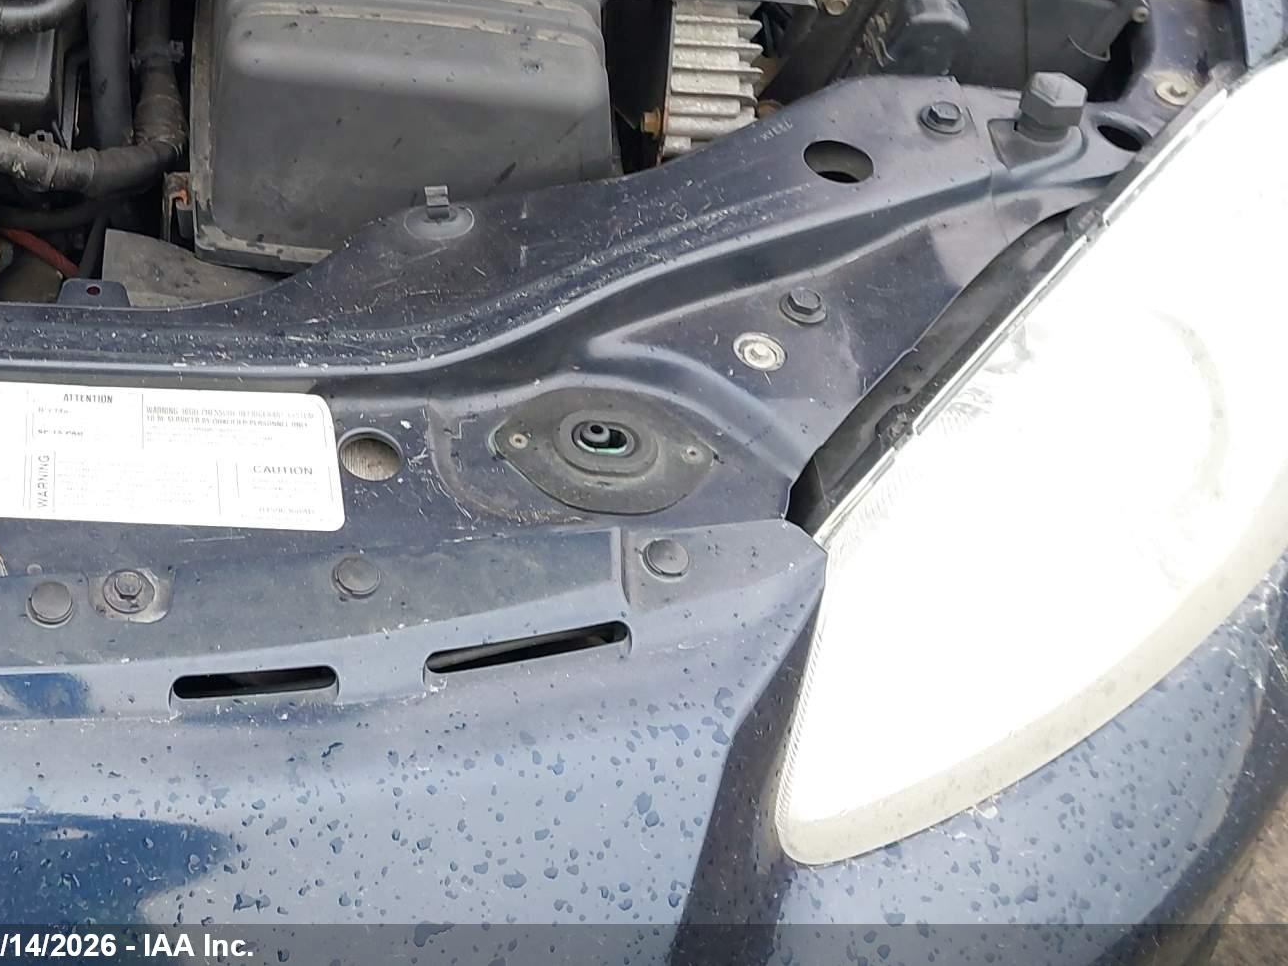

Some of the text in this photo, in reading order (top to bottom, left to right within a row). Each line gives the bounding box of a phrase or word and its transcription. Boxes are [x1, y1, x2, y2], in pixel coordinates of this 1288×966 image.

[63, 393, 113, 404] ATTENTION
[253, 465, 313, 475] CAUTION
[37, 454, 50, 508] WARNING
